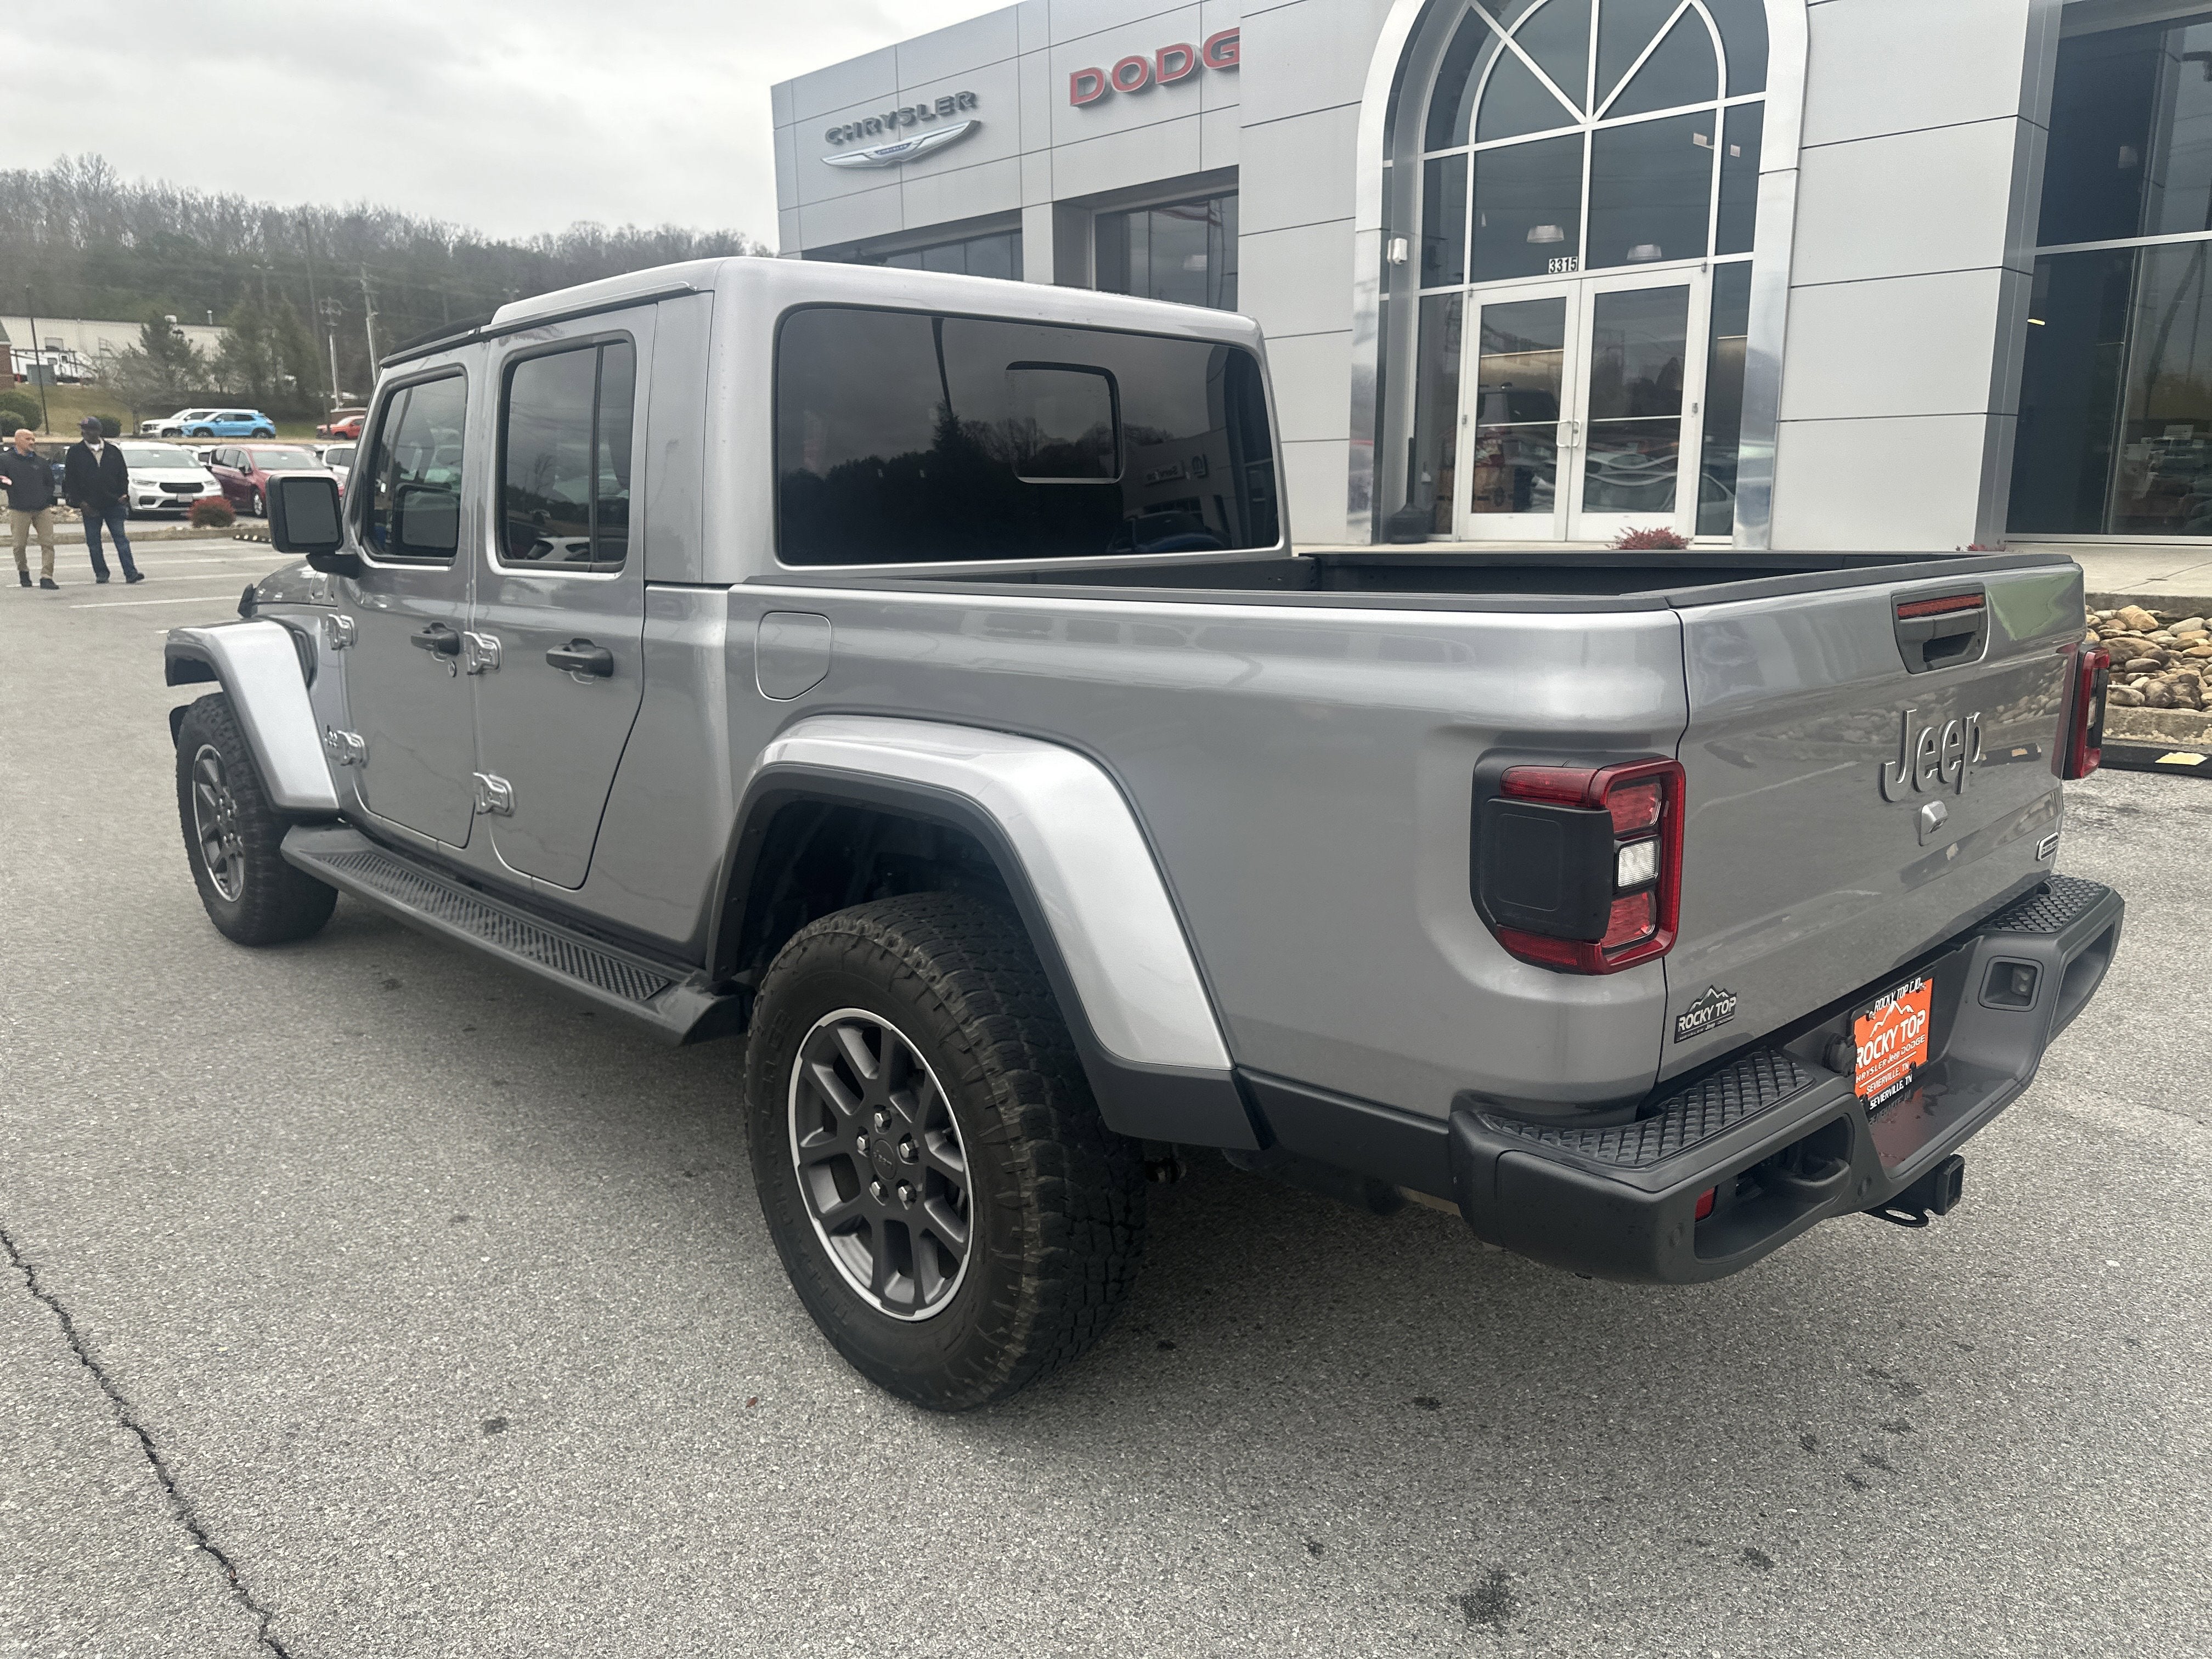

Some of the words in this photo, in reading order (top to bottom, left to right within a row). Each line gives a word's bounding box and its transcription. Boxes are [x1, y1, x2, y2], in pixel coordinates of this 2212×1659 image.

[1070, 27, 1239, 106] DODG
[825, 91, 977, 145] CHRYSLER
[1550, 258, 1577, 273] 3315
[1880, 709, 1982, 802] Jeep
[1678, 1005, 1714, 1032] ROCKY
[1716, 996, 1737, 1017] TOP
[1874, 991, 1897, 1013] ROCKY
[1897, 984, 1909, 1000] TOP
[1855, 1058, 1887, 1084] HRYSLER
[1888, 1051, 1900, 1064] Jeep
[1900, 1034, 1926, 1056] DODGE
[1857, 1024, 1899, 1069] ROCKY
[1900, 1009, 1926, 1043] TOP
[1901, 1060, 1910, 1073] TN
[1905, 1073, 1913, 1086] TN
